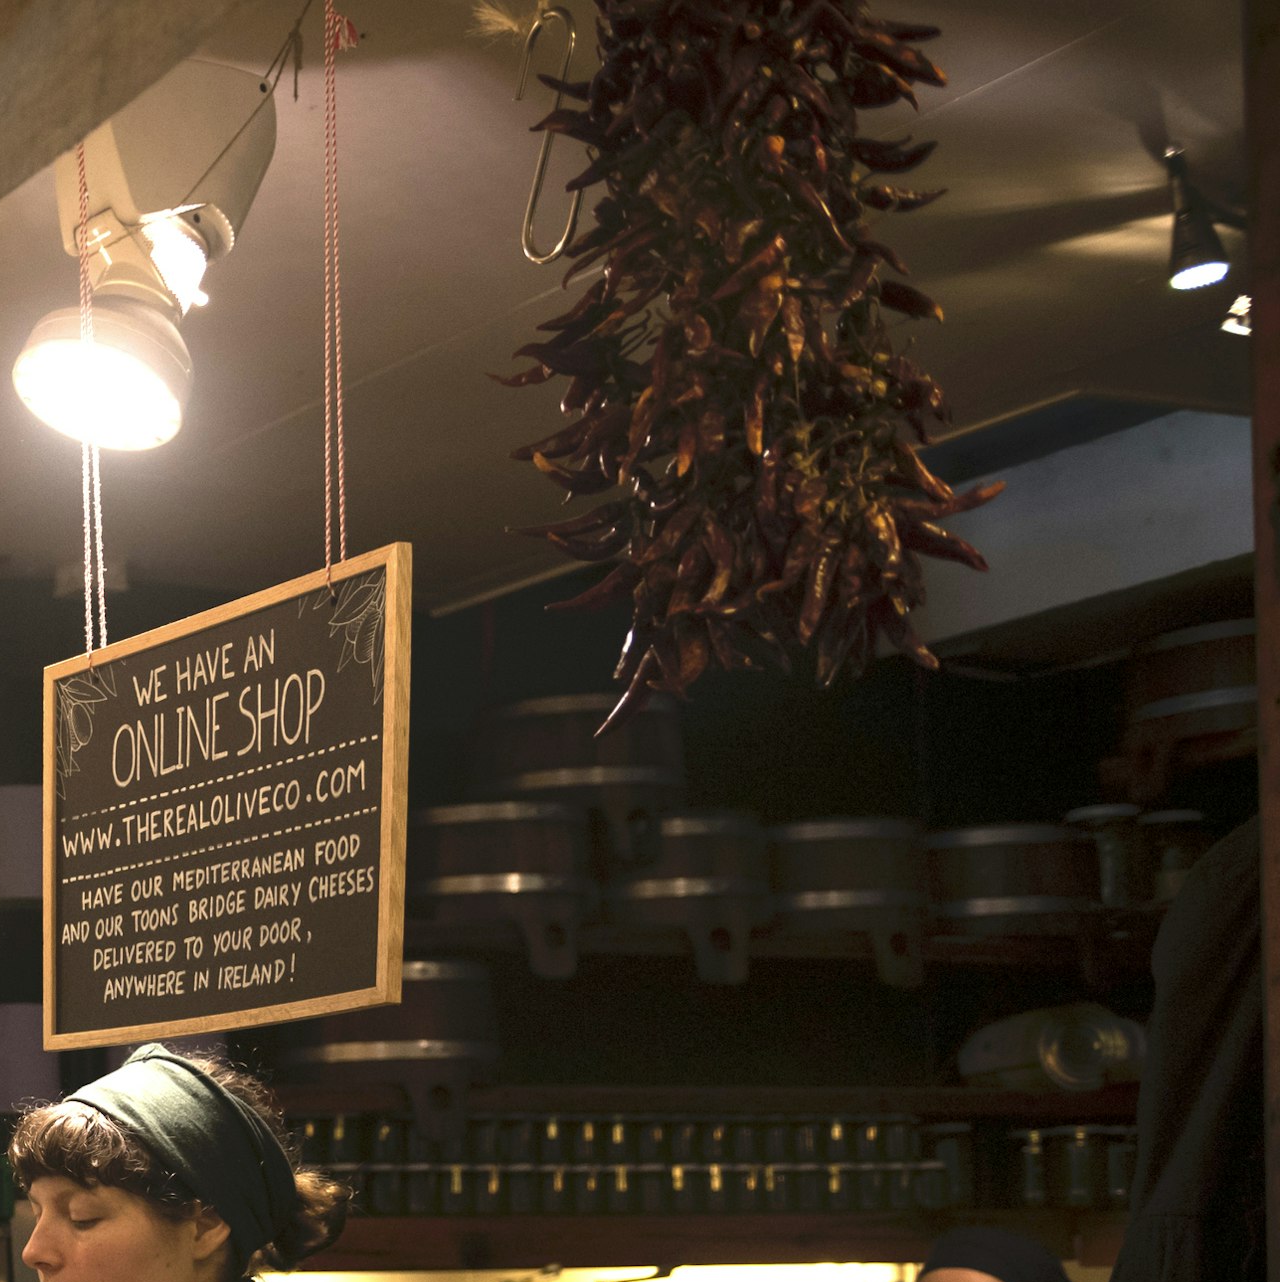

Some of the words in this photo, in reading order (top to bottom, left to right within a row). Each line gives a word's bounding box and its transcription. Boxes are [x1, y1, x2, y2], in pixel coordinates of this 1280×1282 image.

[133, 664, 167, 706] WE
[176, 642, 235, 694] HAVE
[243, 628, 275, 674] AN
[112, 691, 229, 788] ONLINE
[237, 668, 325, 757] SHOP
[62, 759, 366, 858] WWW.THEREALOLIVECO.COM
[61, 920, 90, 945] AND
[95, 914, 123, 940] OUR
[131, 904, 179, 932] TOONS
[189, 889, 247, 923] BRIDGE
[254, 881, 302, 911] DAIRY
[308, 866, 375, 902] CHEESES
[81, 883, 123, 911] HAVE
[130, 875, 163, 902] OUR
[173, 847, 305, 892] MEDITERRANEAN
[314, 833, 360, 865] FOOD
[93, 940, 176, 972] DELIVERED
[184, 937, 204, 961] TO
[213, 926, 252, 956] YOUR
[104, 970, 186, 1003] ANYWHERE
[193, 968, 209, 992] IN
